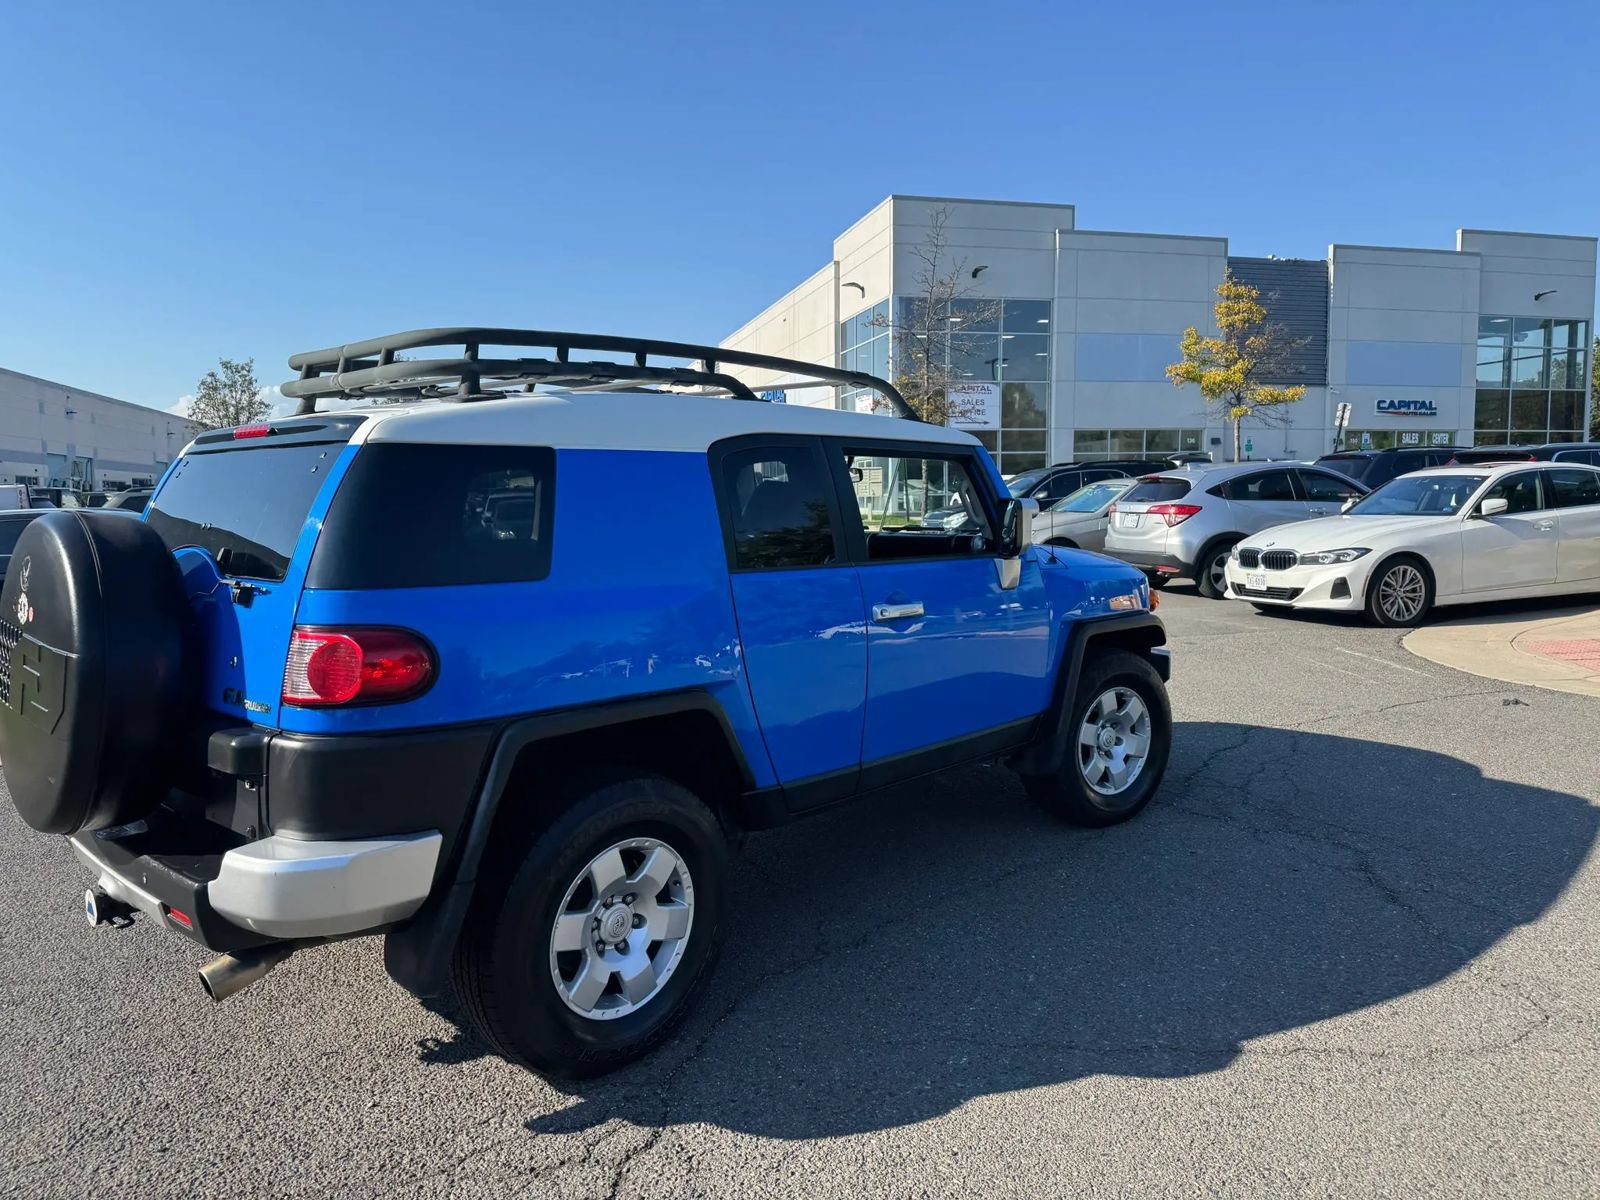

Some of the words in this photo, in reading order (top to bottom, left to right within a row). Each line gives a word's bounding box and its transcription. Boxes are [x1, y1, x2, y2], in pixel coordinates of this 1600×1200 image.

[1376, 399, 1437, 410] CAPITAL
[1401, 432, 1419, 444] SALES
[1432, 432, 1449, 445] CENTER
